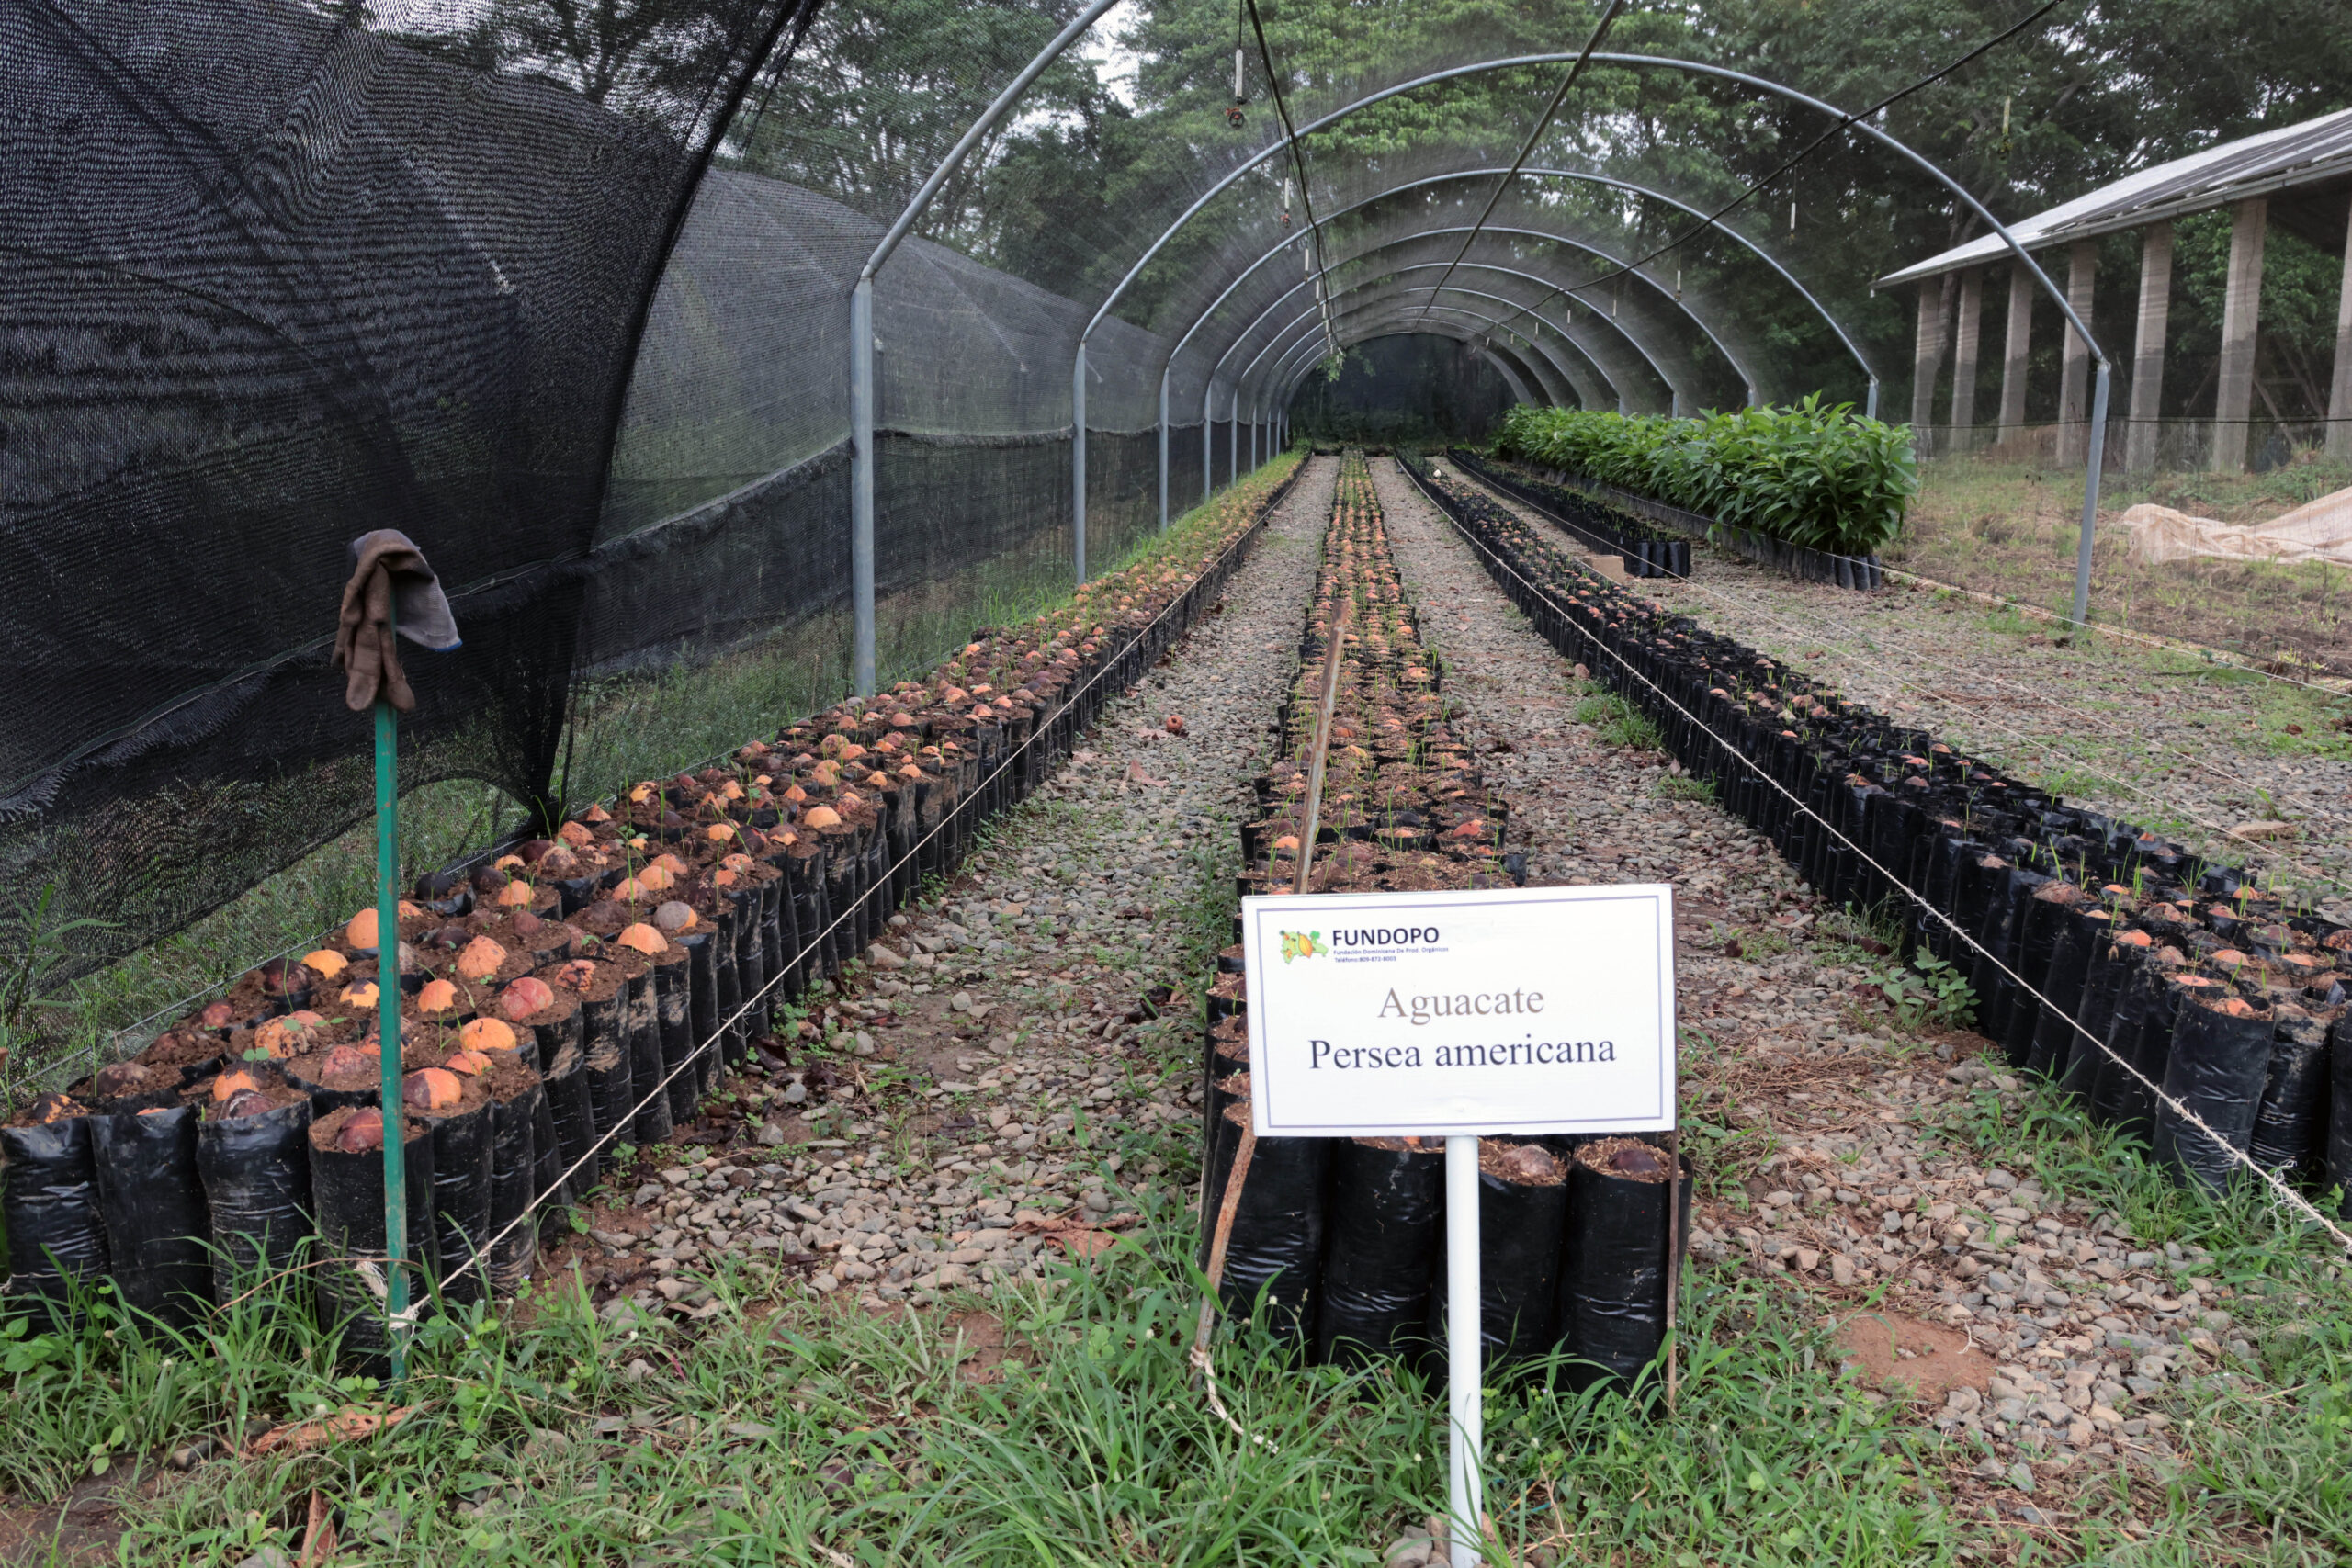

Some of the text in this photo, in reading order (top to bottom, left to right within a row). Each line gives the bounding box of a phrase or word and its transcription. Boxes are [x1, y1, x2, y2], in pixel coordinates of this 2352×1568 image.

[1332, 927, 1440, 946] FUNDOPO
[1377, 987, 1544, 1026] Aguacate
[1308, 1032, 1617, 1069] Persea americana
